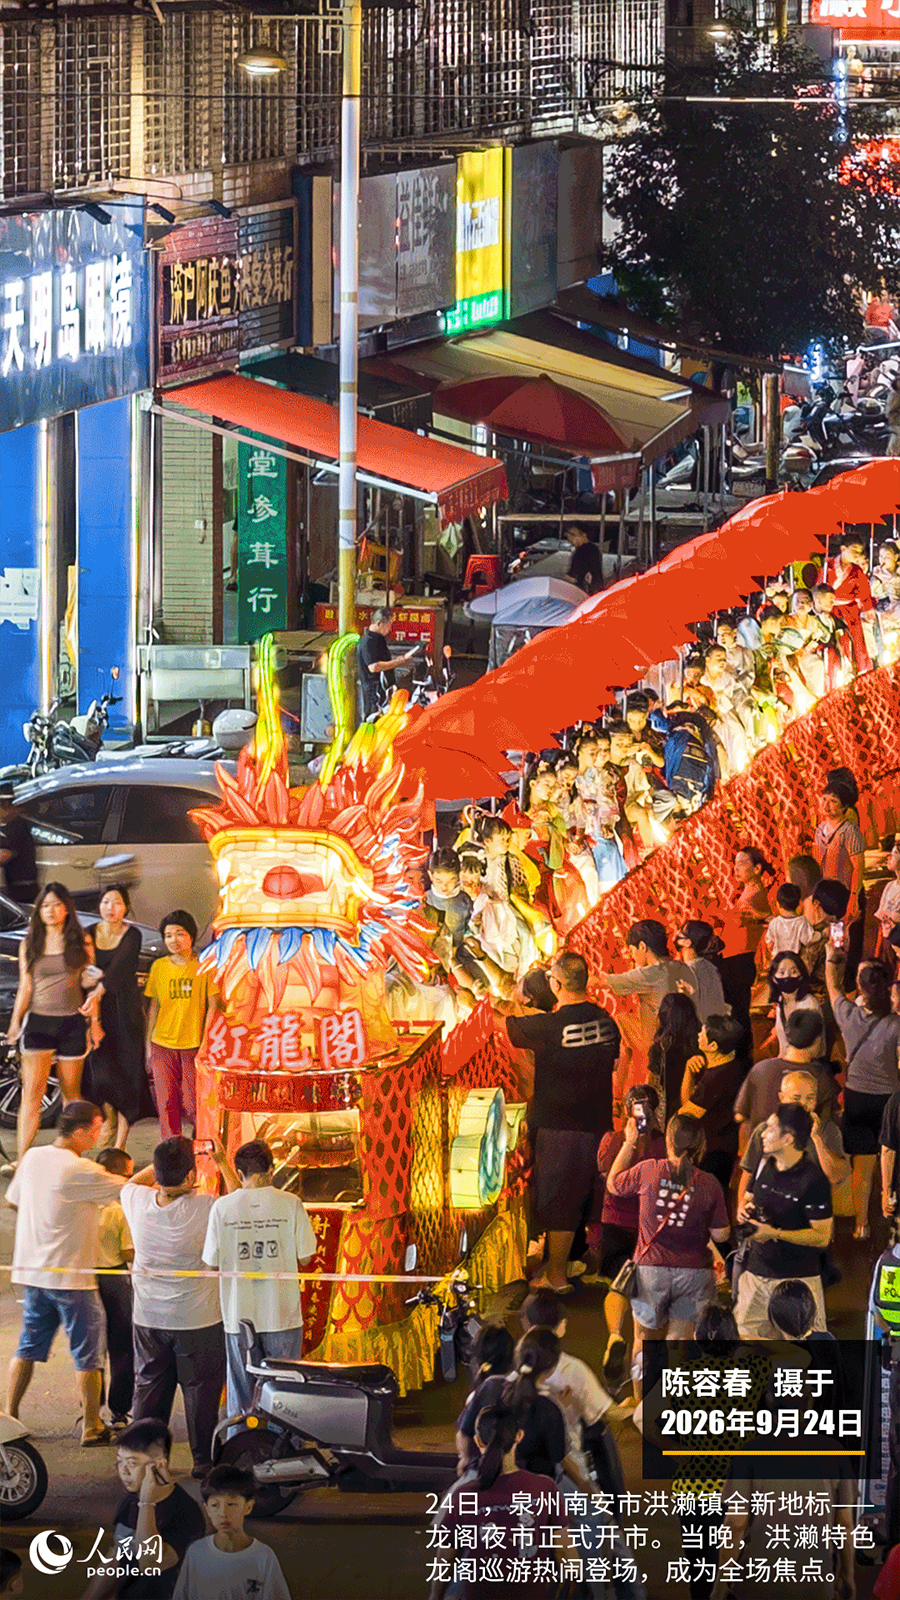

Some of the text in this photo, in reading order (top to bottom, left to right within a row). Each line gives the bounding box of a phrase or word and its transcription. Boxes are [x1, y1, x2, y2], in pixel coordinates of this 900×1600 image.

[247, 450, 278, 613] 堂参茸行
[207, 1009, 365, 1069] 紅龍閣
